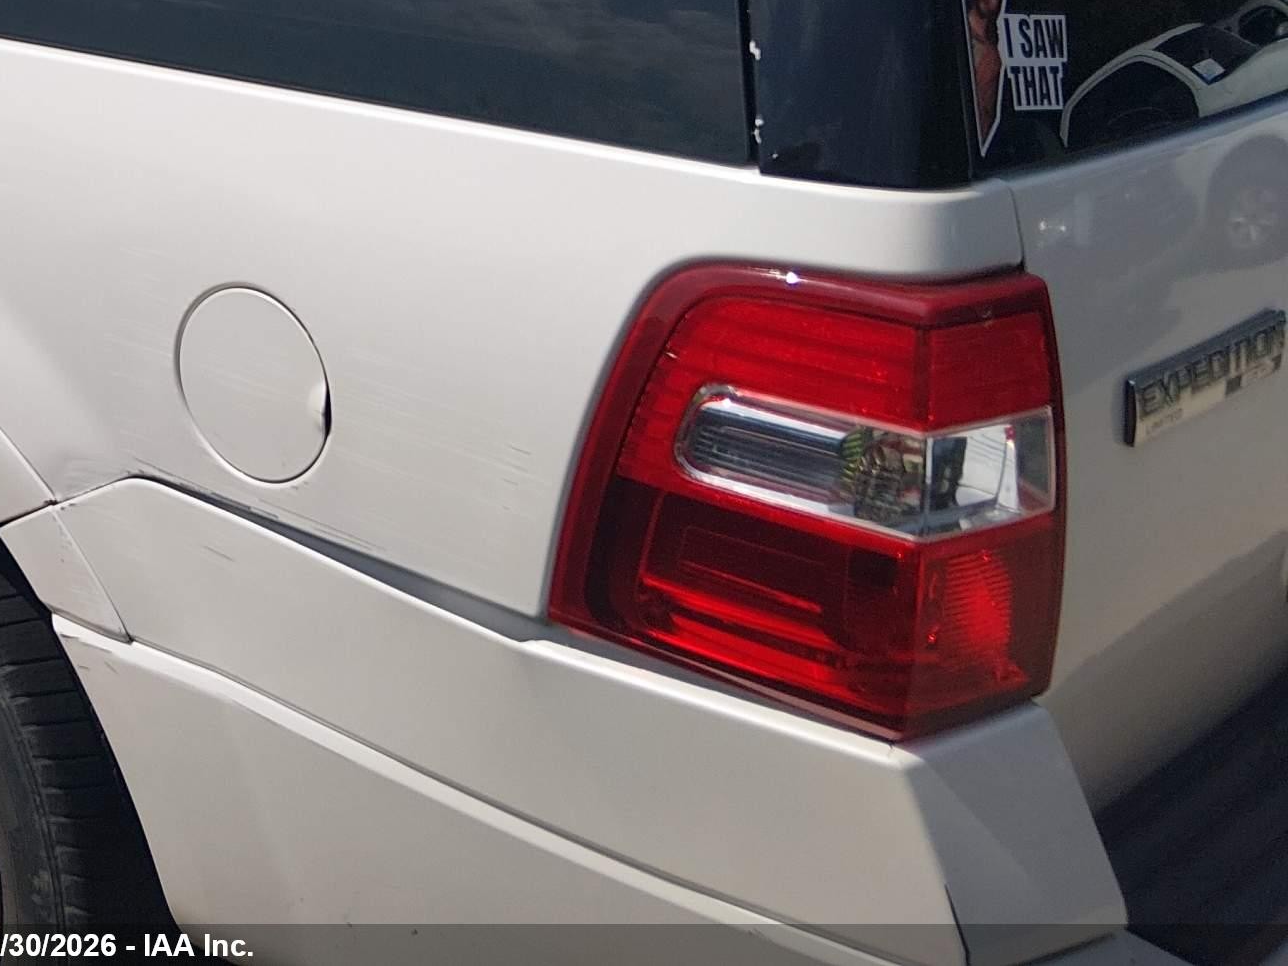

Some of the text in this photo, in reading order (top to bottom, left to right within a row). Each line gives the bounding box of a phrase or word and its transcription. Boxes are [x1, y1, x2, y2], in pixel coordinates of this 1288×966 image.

[1004, 17, 1064, 58] I SAW
[1010, 66, 1061, 106] THAT
